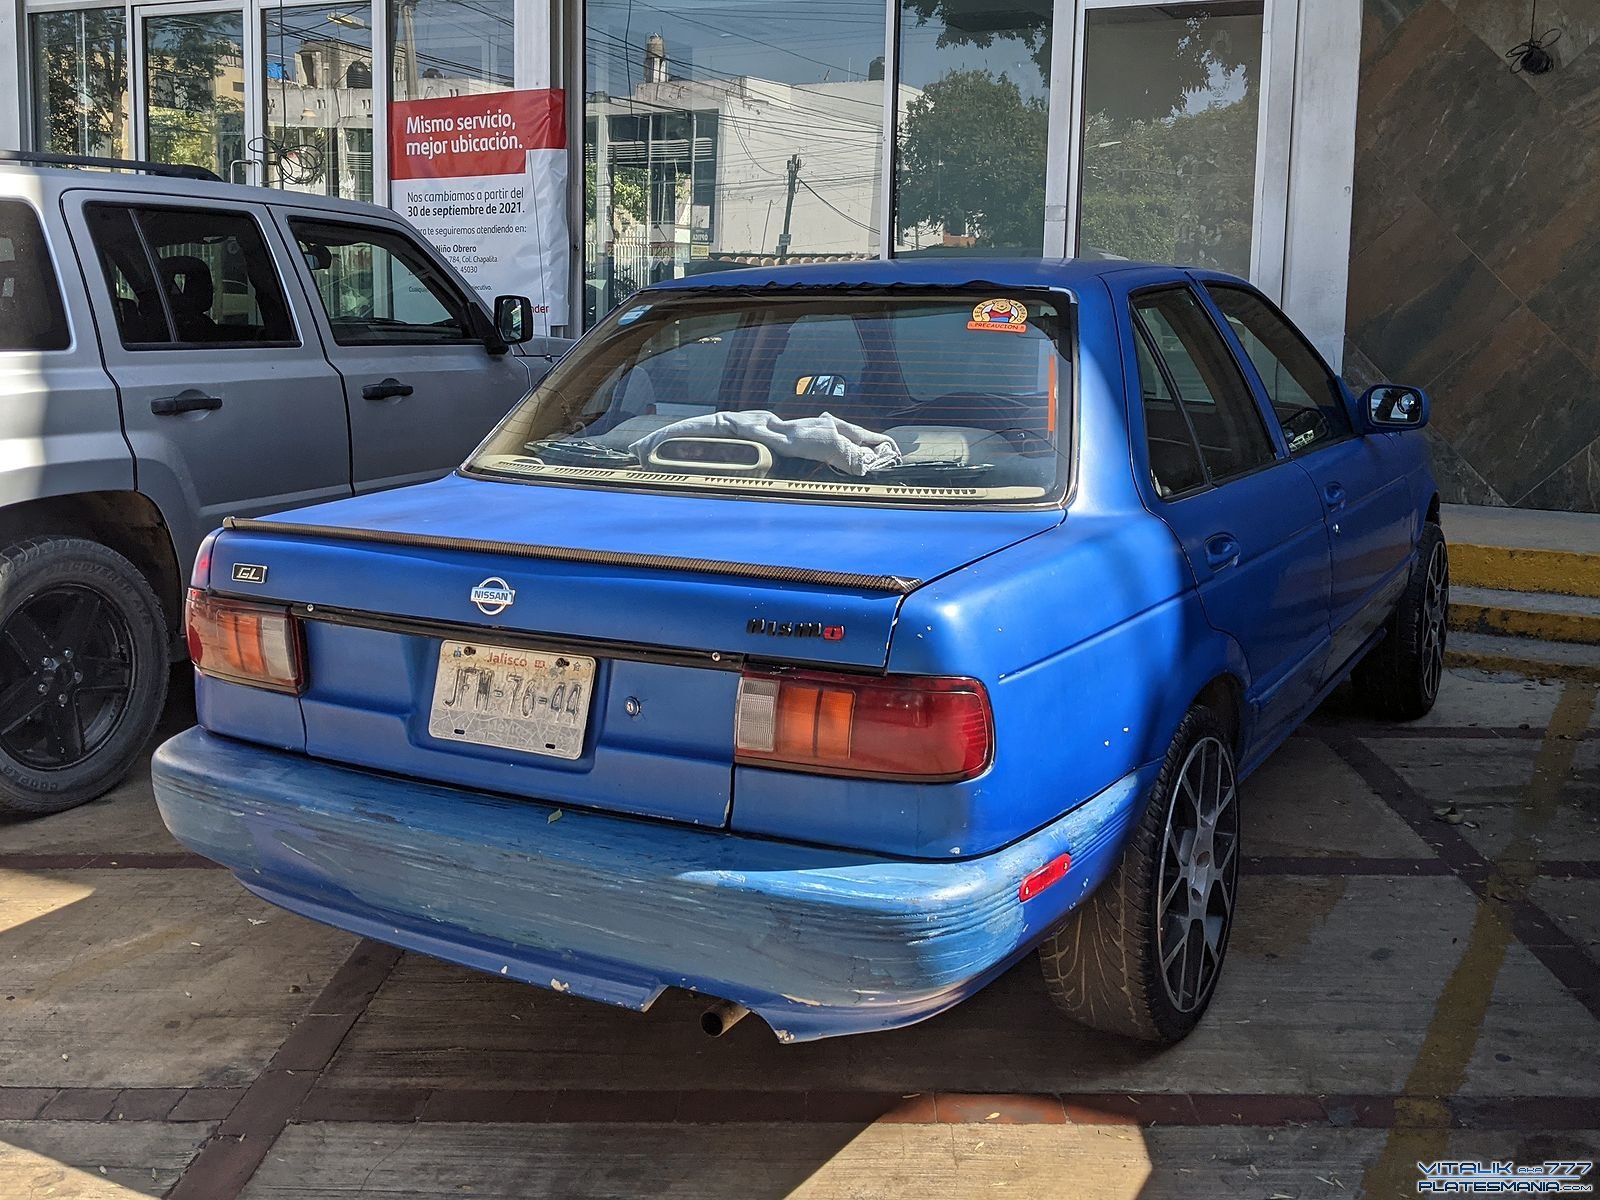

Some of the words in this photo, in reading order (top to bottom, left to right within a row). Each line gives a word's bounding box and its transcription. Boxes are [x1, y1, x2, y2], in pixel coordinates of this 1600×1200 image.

[406, 115, 454, 134] Mismo
[457, 108, 516, 130] servicio,
[406, 137, 448, 160] mejor
[451, 130, 523, 153] ubicación.
[407, 191, 423, 203] Nos
[424, 190, 475, 202] cambiamos
[476, 191, 482, 200] a
[484, 188, 509, 202] partir
[510, 187, 524, 199] del
[407, 206, 418, 217] 30
[420, 205, 431, 216] de
[432, 204, 484, 218] septiembre
[486, 203, 497, 214] de
[499, 202, 525, 214] 2021.
[427, 227, 434, 235] te
[435, 226, 475, 238] seguiremos
[476, 225, 514, 235] atendiendo
[515, 225, 527, 233] en:
[452, 244, 477, 253] Obrero
[472, 255, 498, 264] Chapalita
[460, 265, 478, 273] 45030
[236, 567, 260, 580] GL
[474, 590, 508, 601] NISSAN
[487, 652, 528, 668] Jalisco
